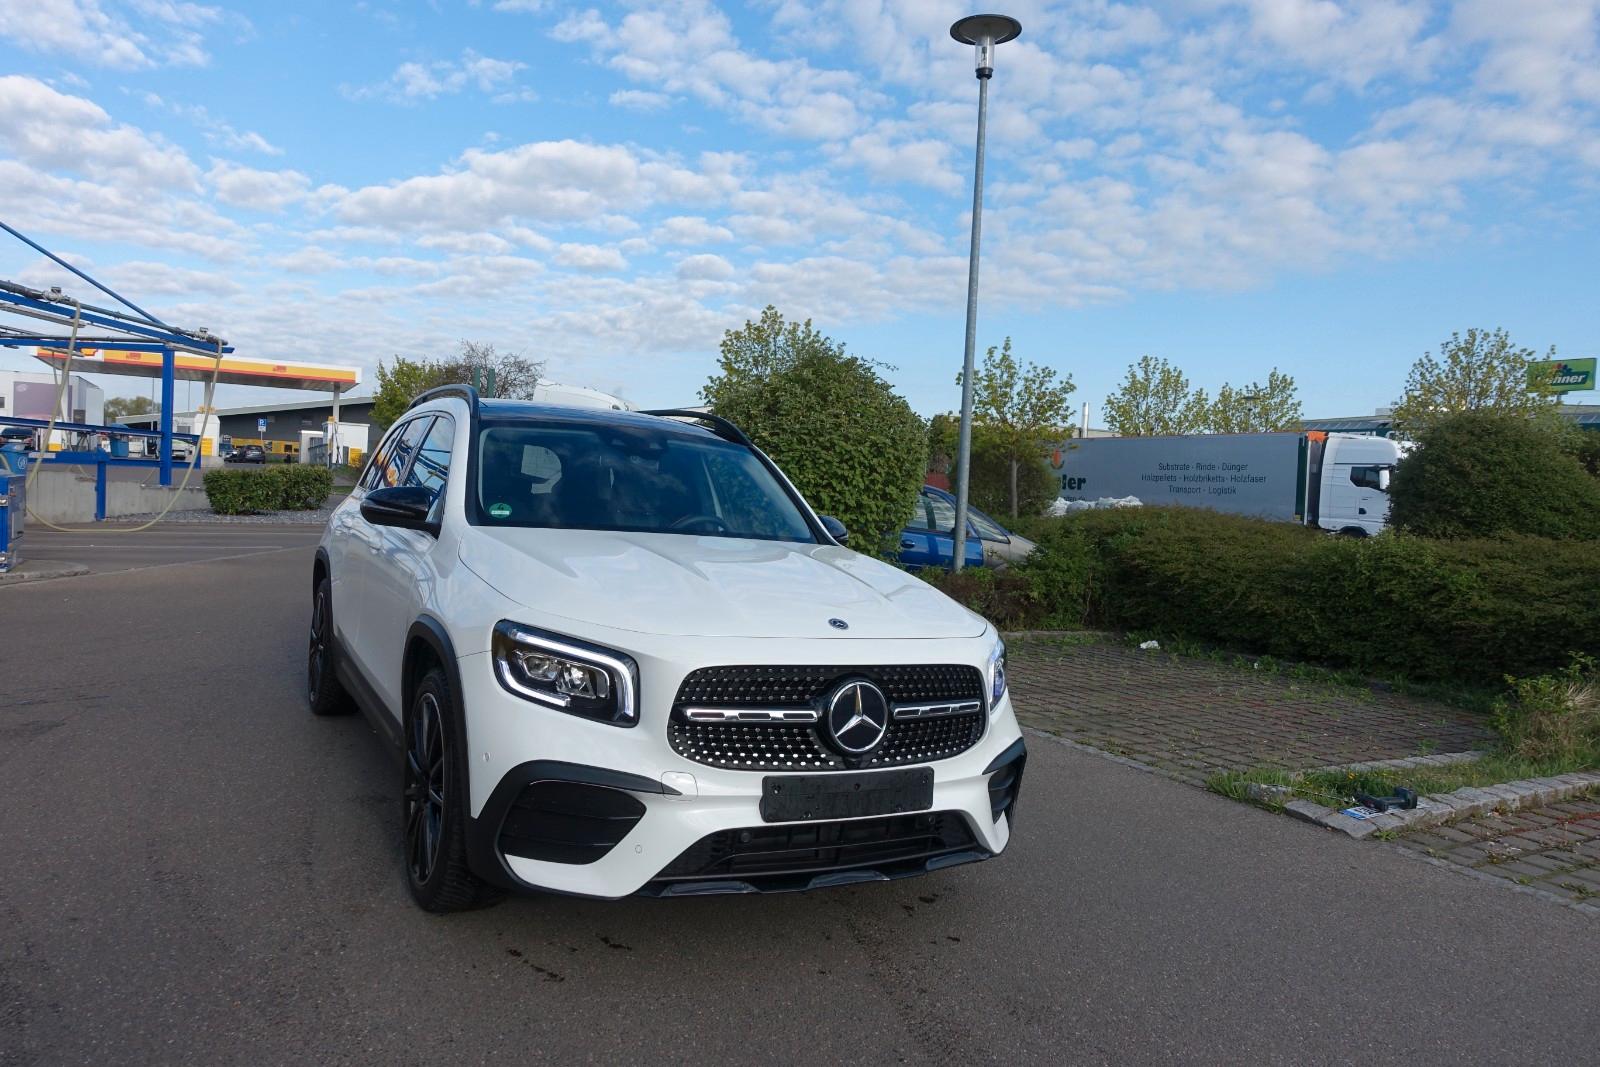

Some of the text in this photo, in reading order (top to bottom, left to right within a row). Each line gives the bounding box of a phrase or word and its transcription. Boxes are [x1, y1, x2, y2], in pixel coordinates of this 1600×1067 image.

[1158, 462, 1248, 473] Substrate Rinde Dünger
[1058, 474, 1086, 490] ler
[1141, 473, 1267, 484] Holzpellets Holzbriketts Holzfaser
[1168, 484, 1237, 496] Transport Logistik
